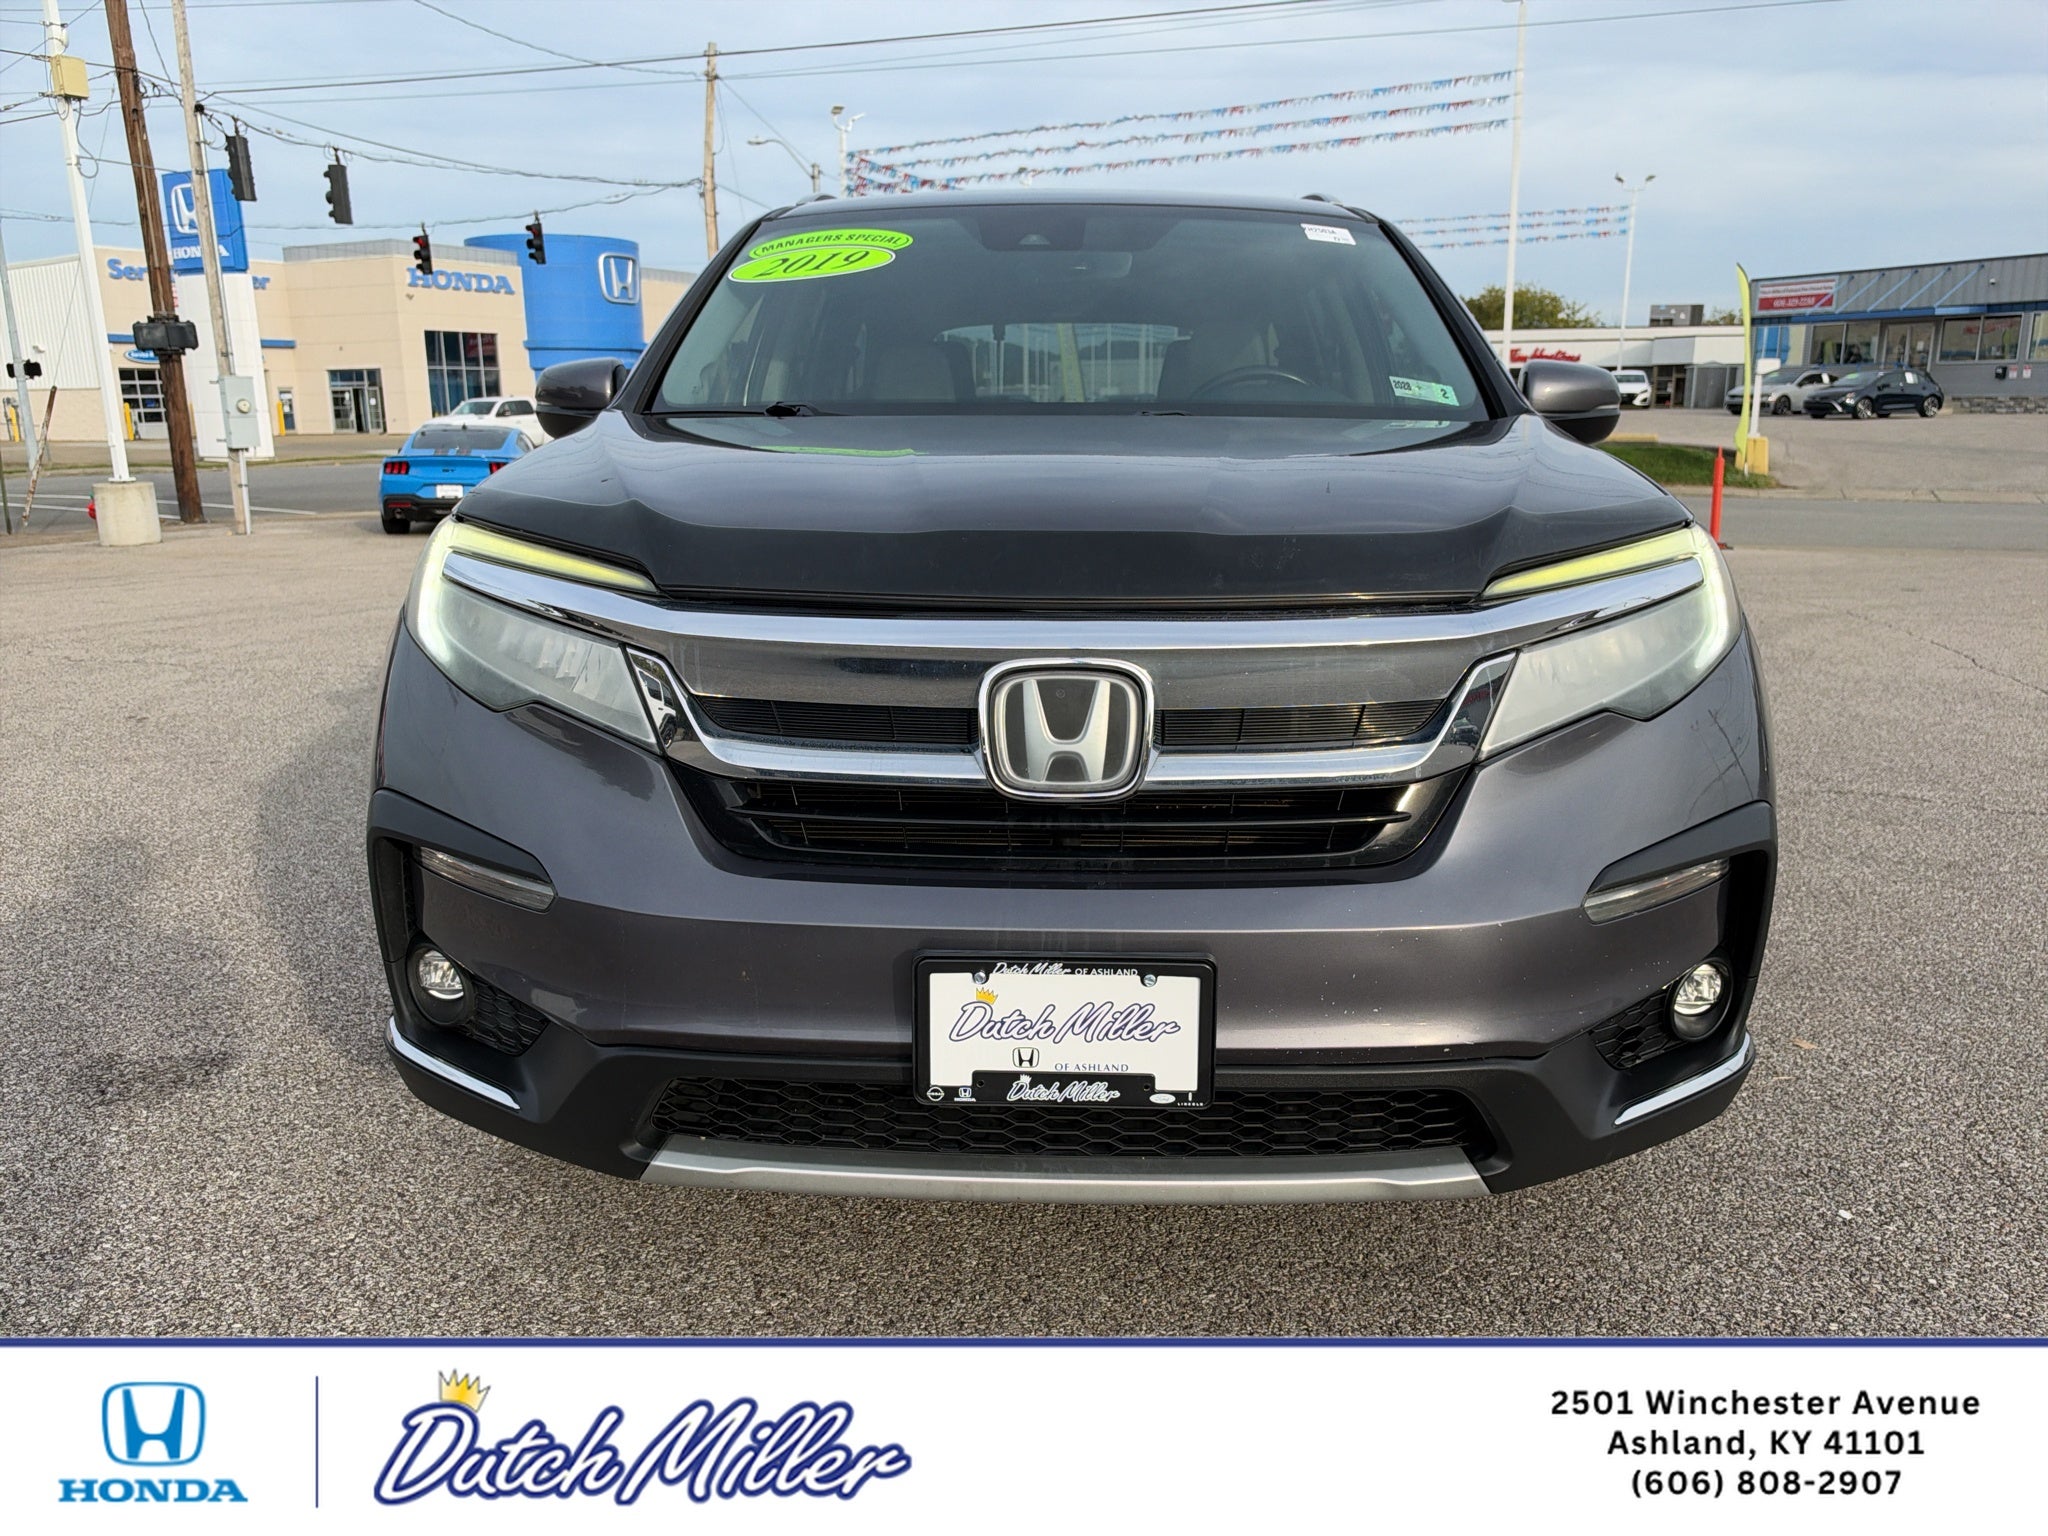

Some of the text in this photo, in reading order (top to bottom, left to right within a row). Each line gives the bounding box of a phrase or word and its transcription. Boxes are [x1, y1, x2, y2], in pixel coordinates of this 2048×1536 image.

[173, 245, 230, 260] HONA
[761, 233, 903, 254] MANAGERS SPECIAL
[752, 250, 871, 279] 2019
[406, 266, 516, 295] HONDA
[992, 960, 1139, 977] Dutch Miller OF ASHLAND
[949, 1001, 1182, 1045] Dutch Miller
[1055, 1063, 1130, 1073] OF ASHLAND
[1006, 1081, 1121, 1103] Dutch Miller
